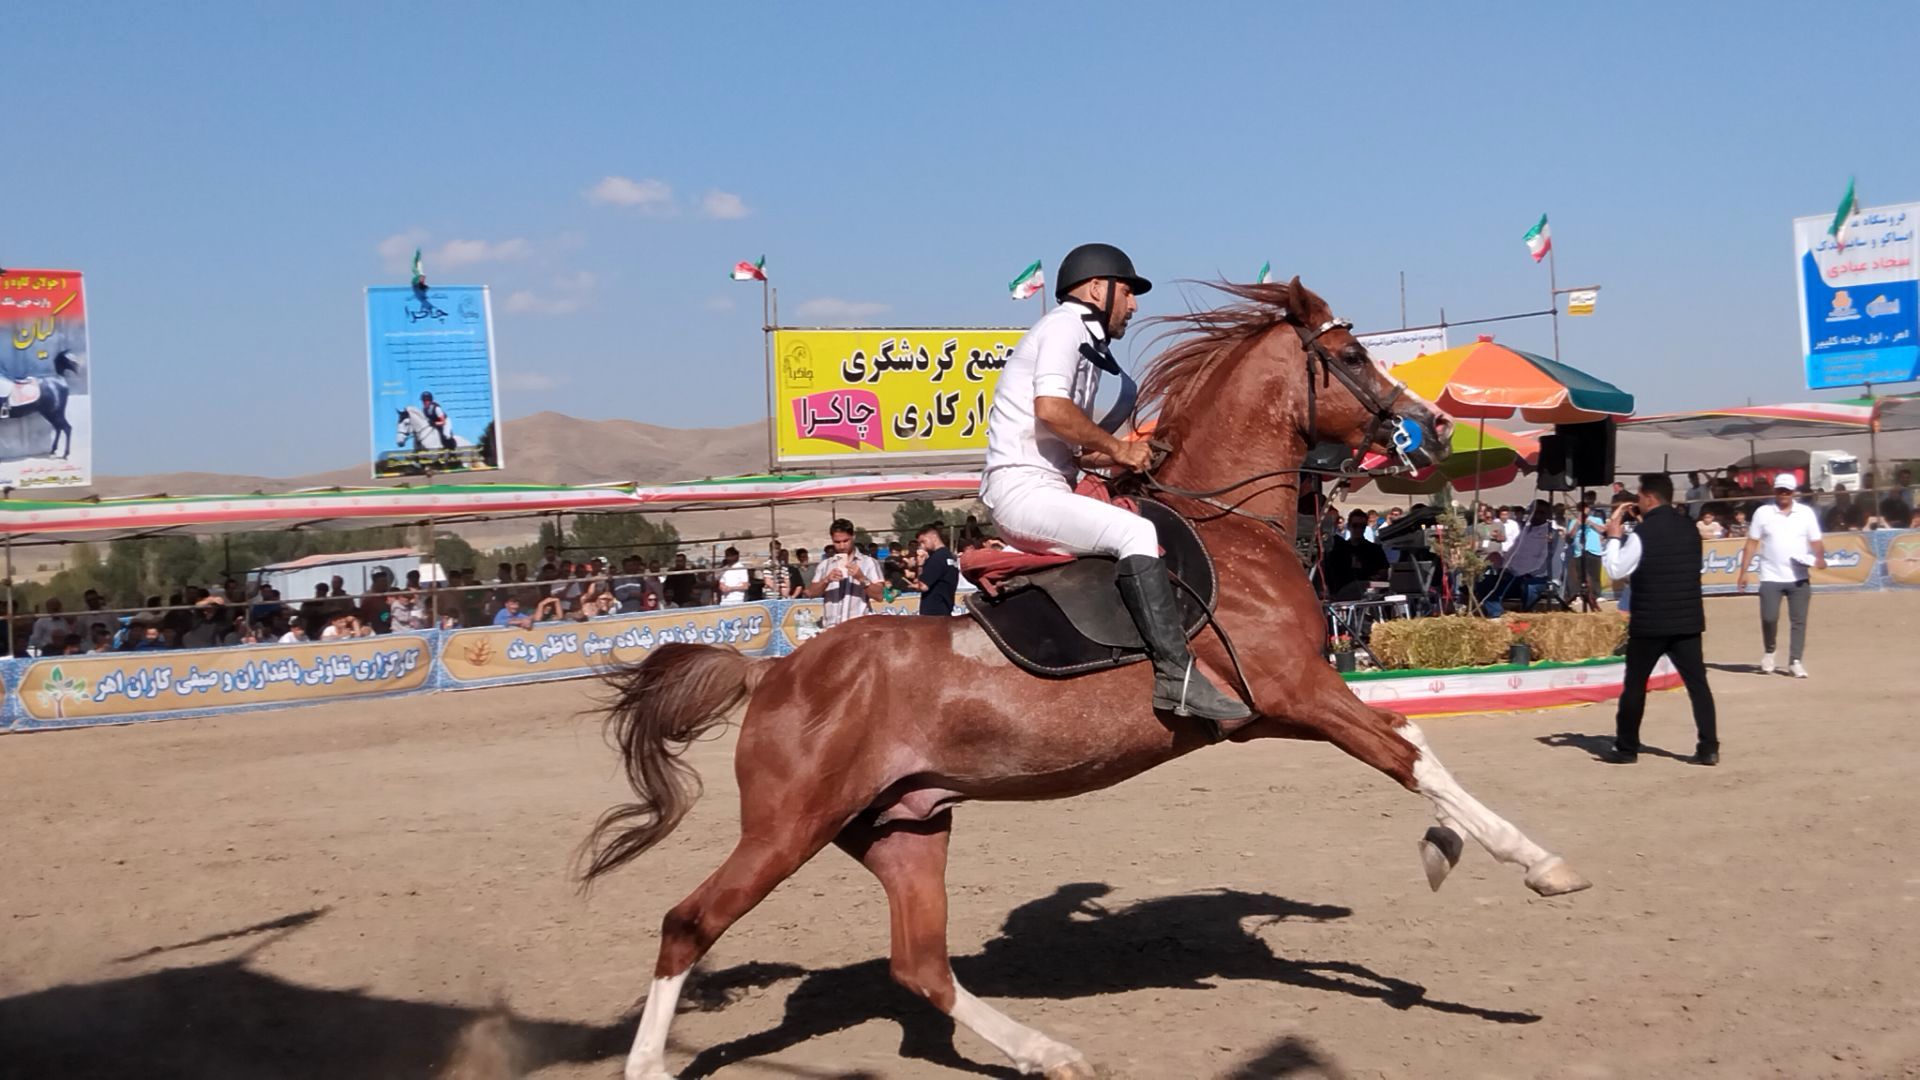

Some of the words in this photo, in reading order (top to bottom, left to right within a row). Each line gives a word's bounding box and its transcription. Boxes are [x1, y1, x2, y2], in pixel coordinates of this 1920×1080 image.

[13, 291, 78, 360] کیان
[842, 339, 957, 382] گردشگری
[965, 342, 1015, 382] تمع
[801, 395, 875, 437] چاکرا
[222, 671, 233, 692] و
[235, 657, 301, 690] باغداران
[304, 655, 351, 684] تعاونی
[354, 649, 420, 681] کارگزاری
[93, 669, 123, 702] اهر
